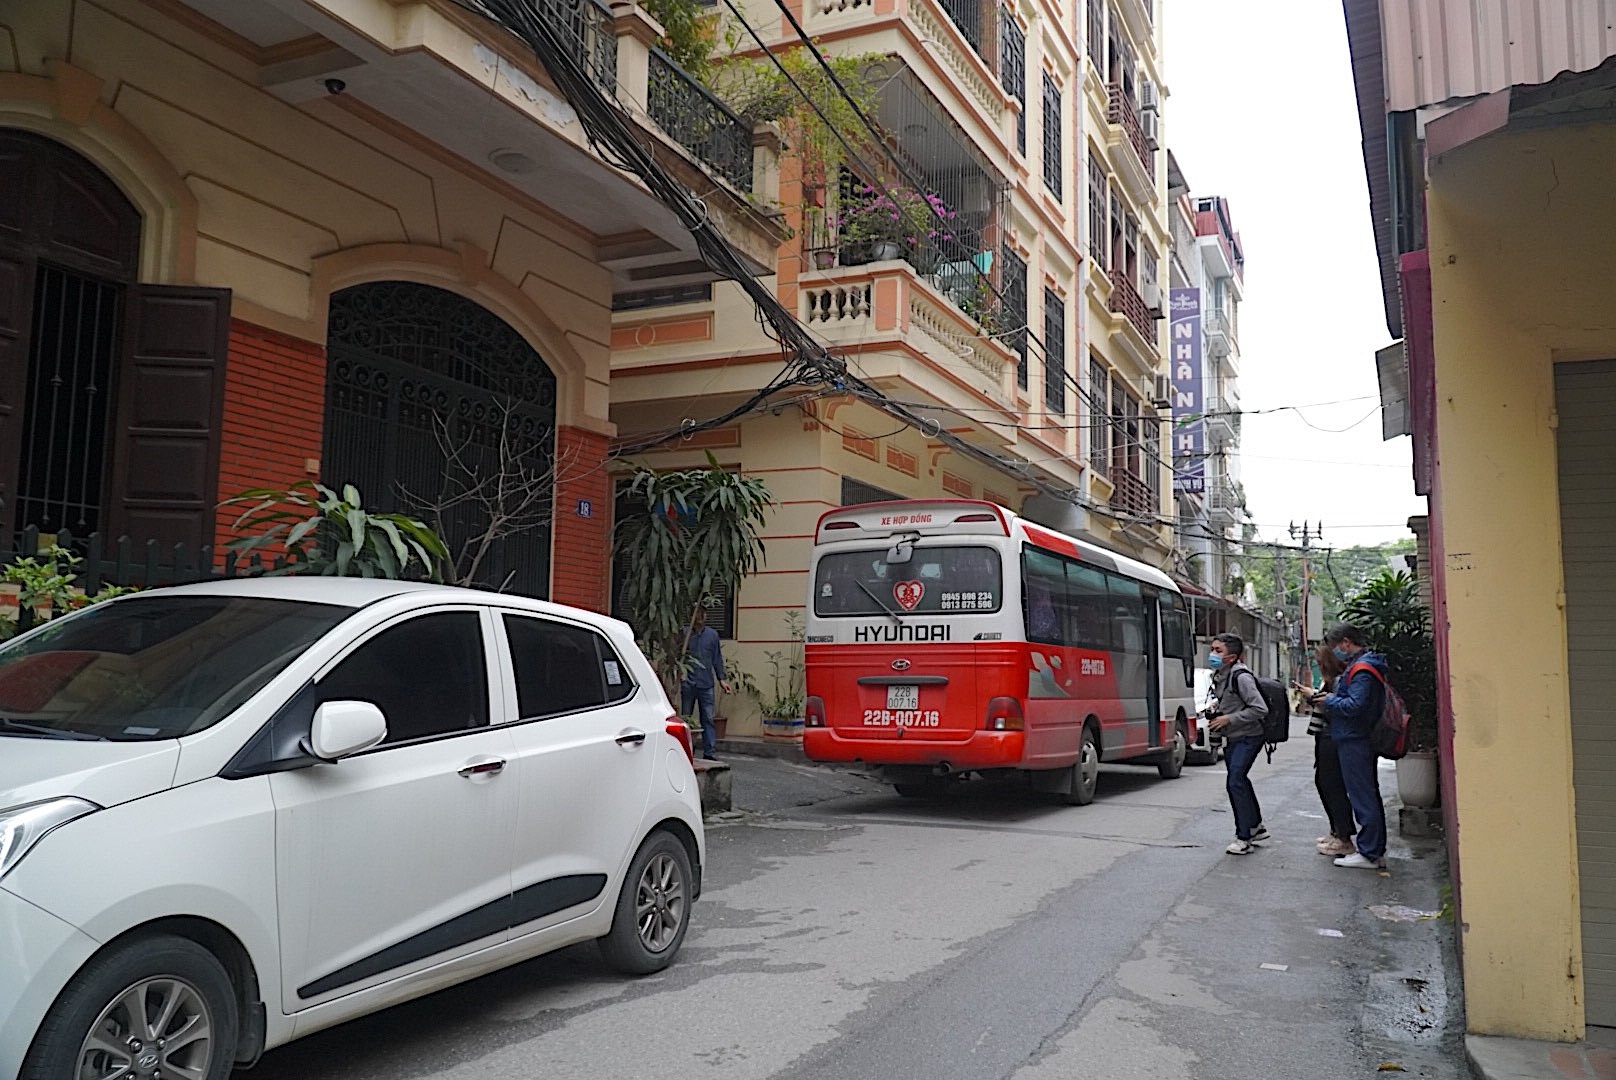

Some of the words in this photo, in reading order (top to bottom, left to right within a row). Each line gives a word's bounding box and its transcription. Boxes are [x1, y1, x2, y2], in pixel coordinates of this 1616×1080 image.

[1174, 322, 1193, 380] NHÀ
[580, 501, 590, 516] 18
[881, 517, 891, 526] XE
[855, 624, 951, 642] HYUNDAI
[894, 686, 911, 698] 22B
[888, 698, 917, 708] 007.16
[863, 709, 940, 727] 22B-007.16
